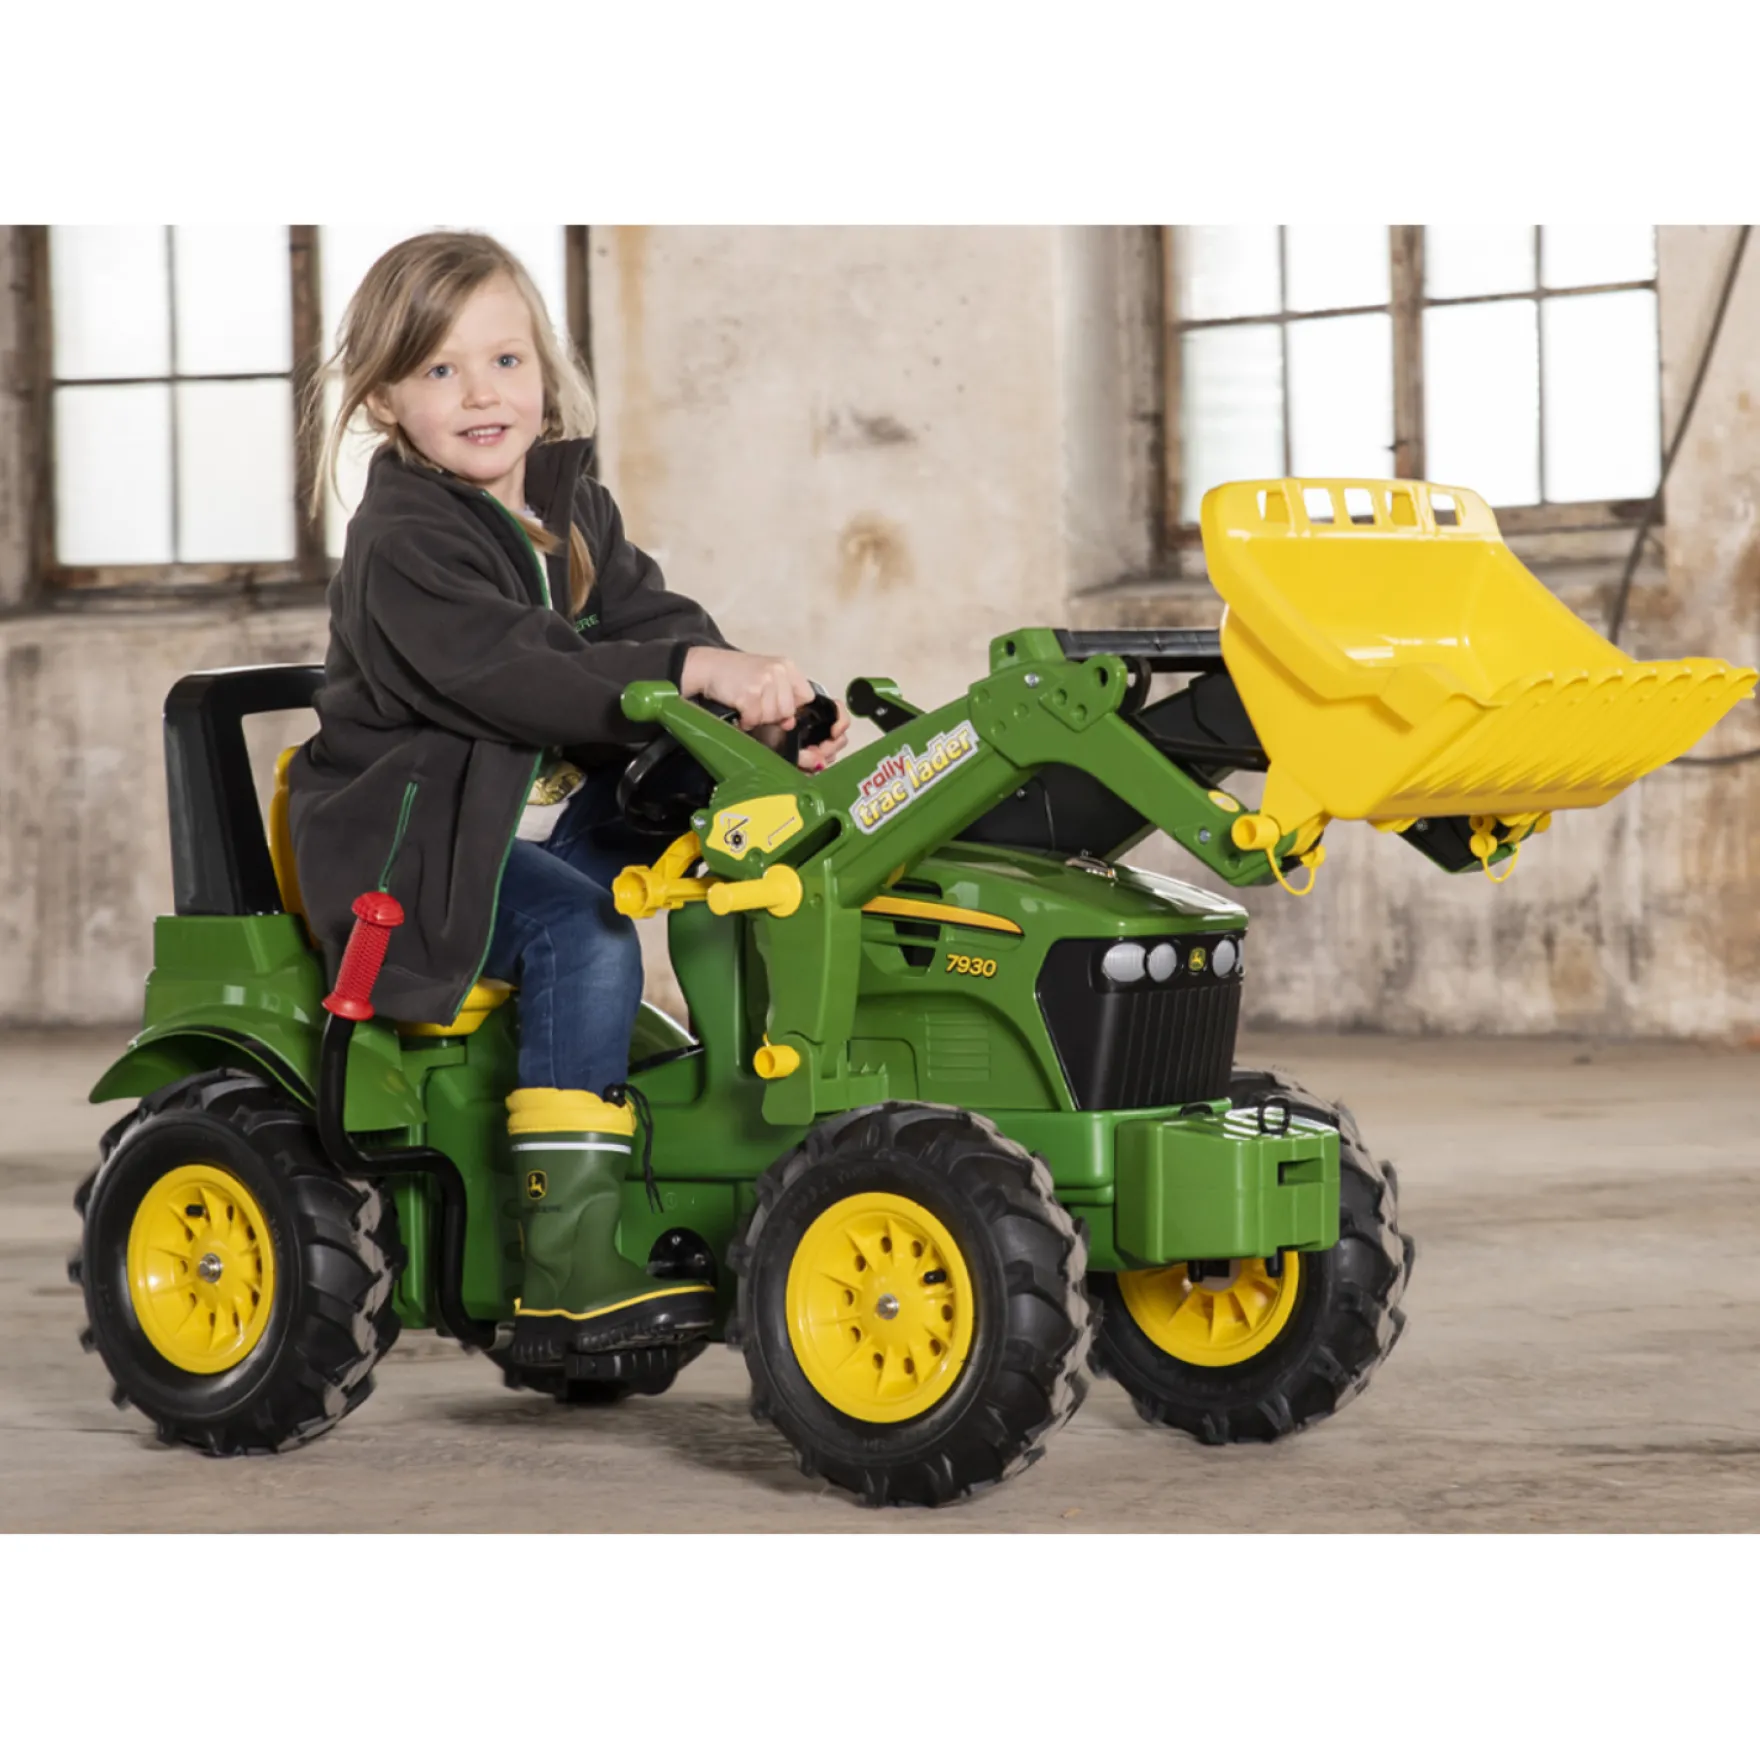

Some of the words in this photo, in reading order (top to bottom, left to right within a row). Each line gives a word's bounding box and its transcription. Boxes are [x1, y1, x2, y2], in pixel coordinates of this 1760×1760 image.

[857, 781, 909, 828] trac
[905, 728, 972, 791] lader
[861, 755, 906, 796] rolly
[946, 953, 998, 978] 7930
